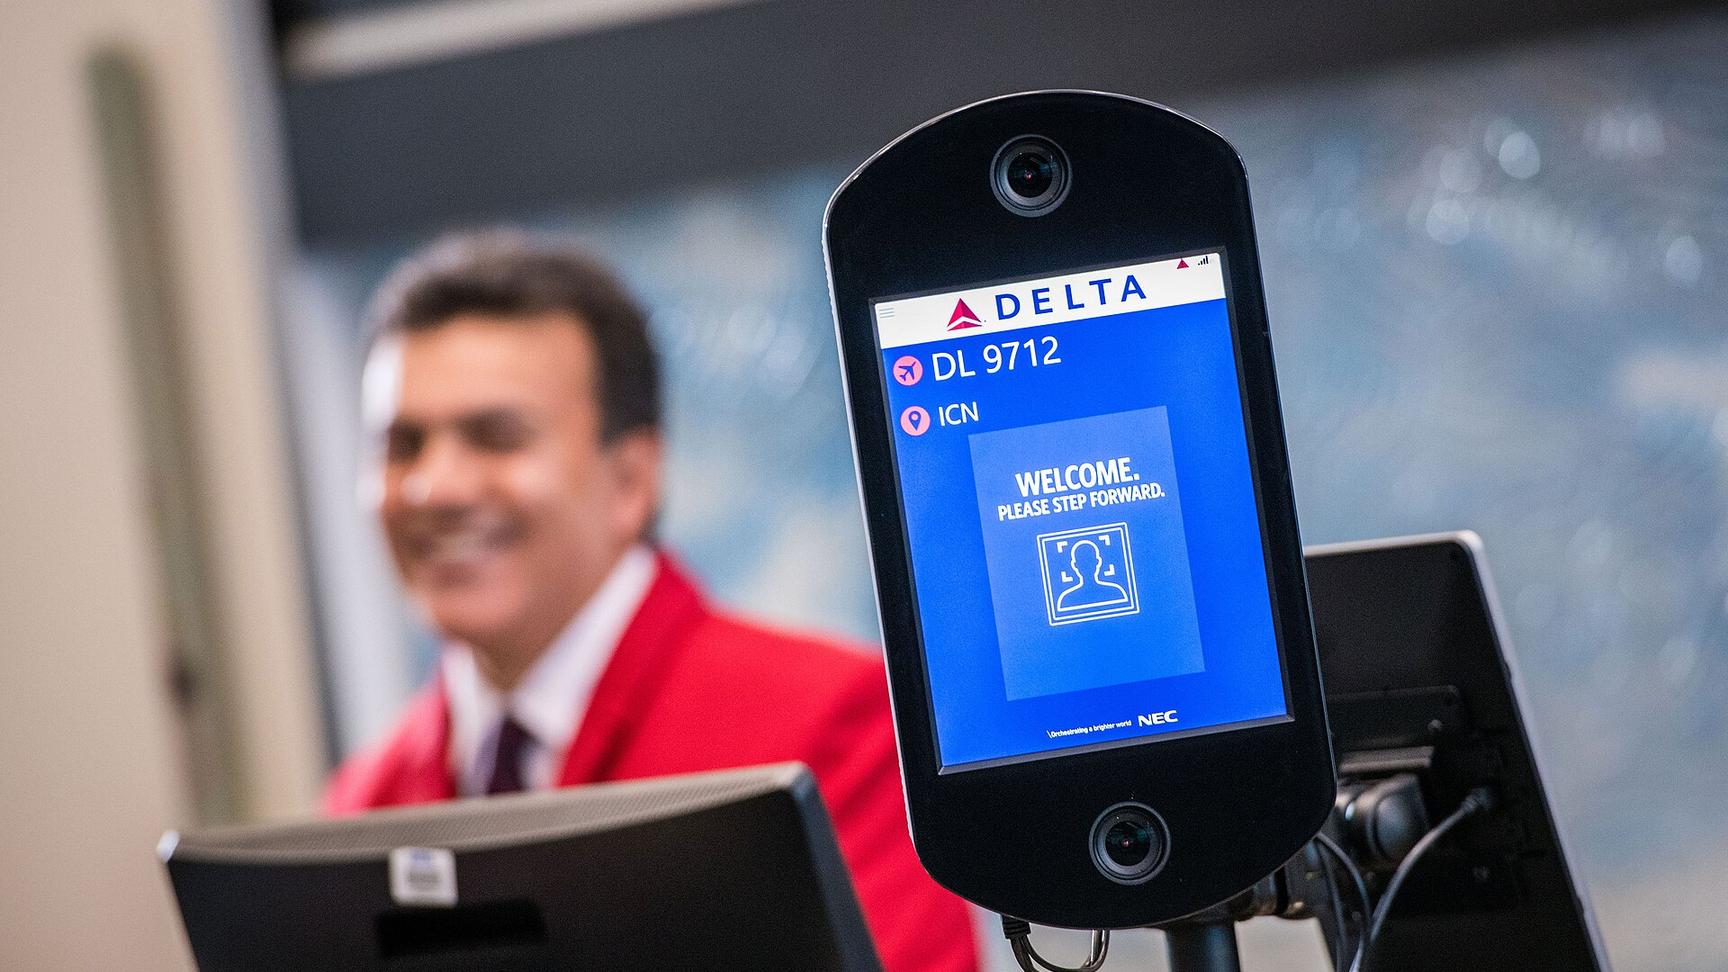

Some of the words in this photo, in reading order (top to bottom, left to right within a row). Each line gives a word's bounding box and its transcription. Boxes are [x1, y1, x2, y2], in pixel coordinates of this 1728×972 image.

[995, 274, 1146, 320] DELTA
[931, 350, 976, 382] DL
[982, 335, 1062, 375] 9712
[937, 401, 980, 427] ICN
[1014, 456, 1140, 498] WELCOME.
[996, 498, 1051, 521] PLEASE
[1052, 493, 1087, 514] STEP
[1089, 482, 1166, 508] FORWARD.
[1093, 723, 1115, 732] brighter
[1115, 720, 1132, 728] world
[1138, 710, 1178, 726] NEC
